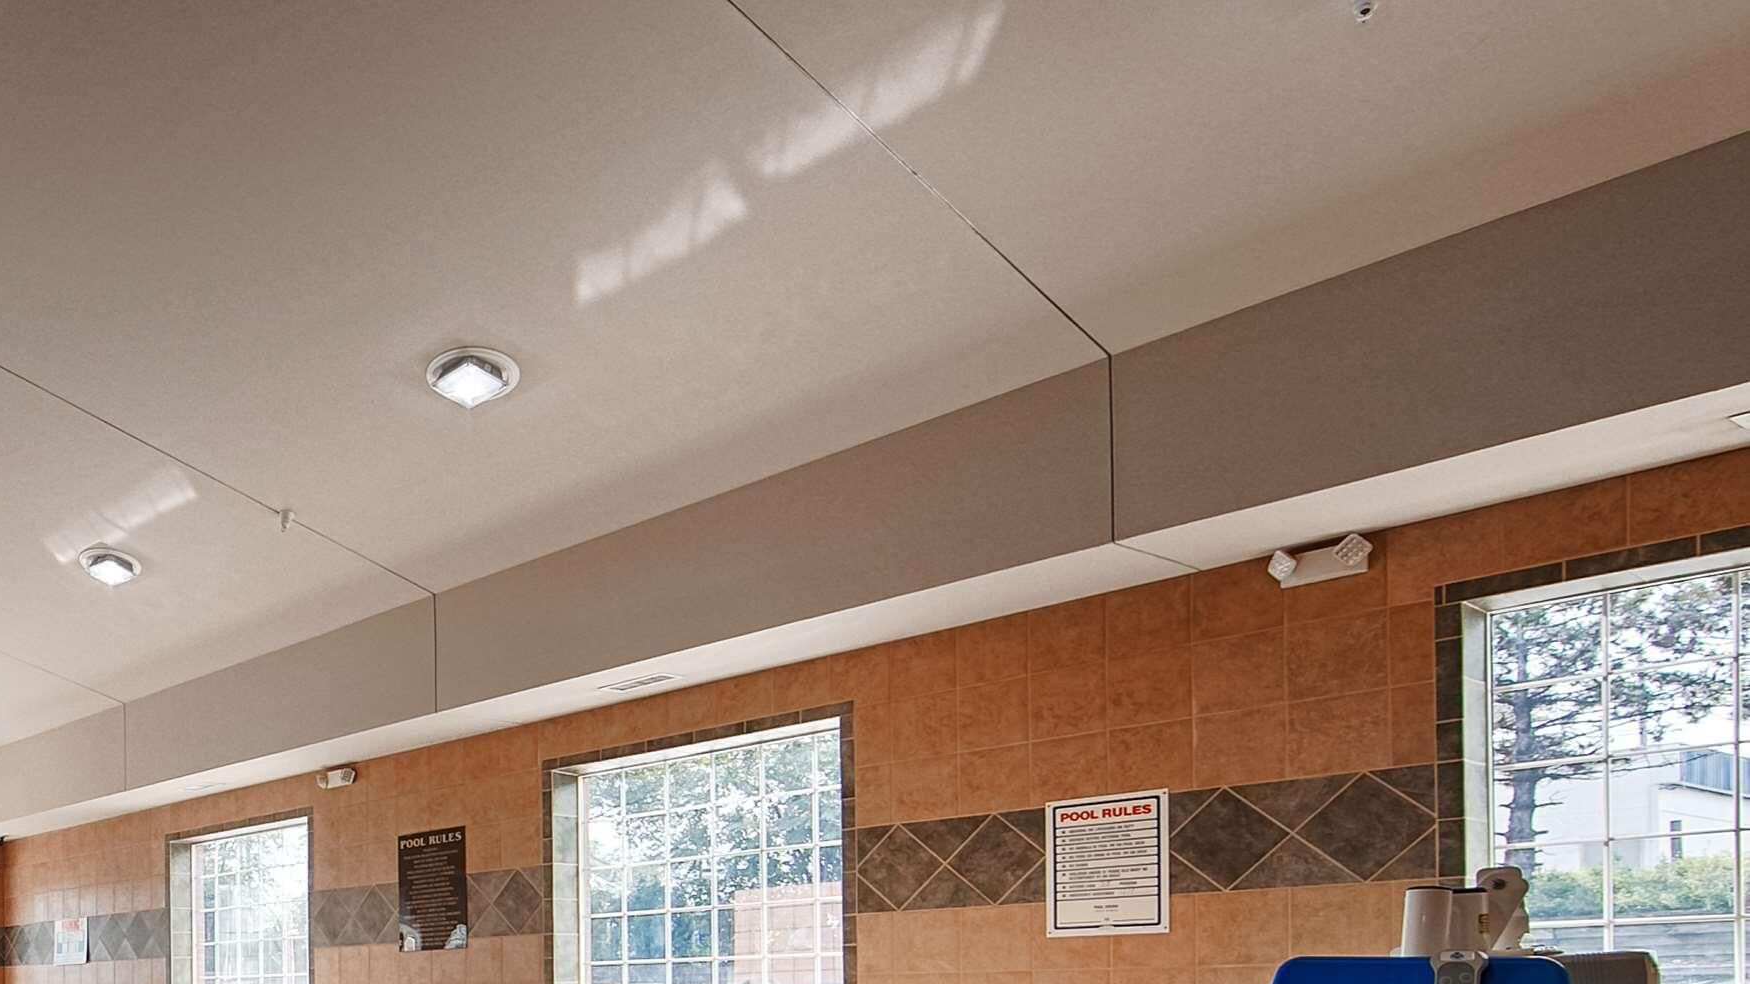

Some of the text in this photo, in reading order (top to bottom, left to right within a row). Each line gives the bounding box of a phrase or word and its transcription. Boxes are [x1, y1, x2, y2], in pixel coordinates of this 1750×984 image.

[1060, 804, 1152, 822] POOL RULES
[400, 832, 462, 849] POOL RULES
